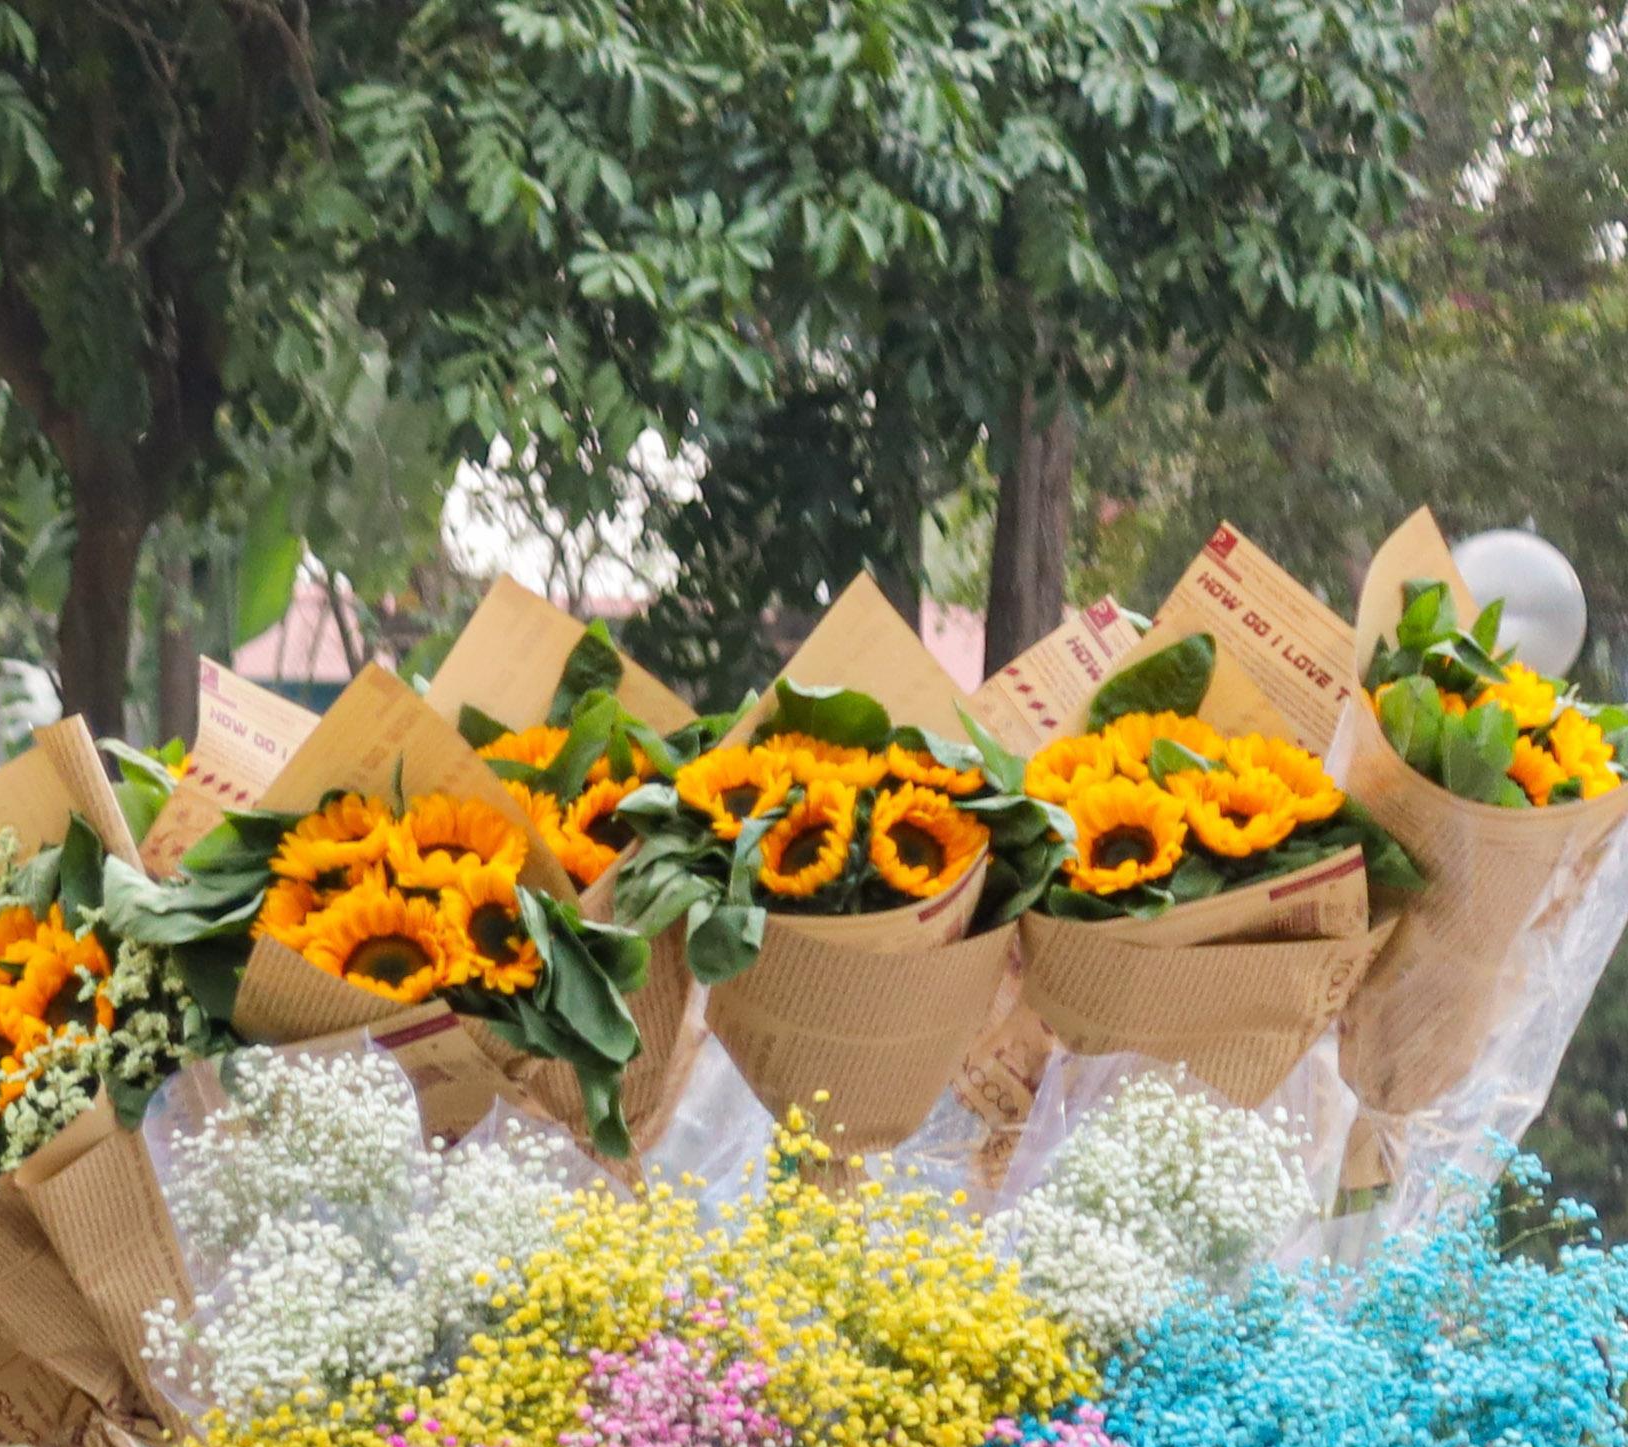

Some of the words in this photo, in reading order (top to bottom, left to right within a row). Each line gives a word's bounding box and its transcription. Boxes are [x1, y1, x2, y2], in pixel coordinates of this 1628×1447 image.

[1197, 571, 1243, 611] HOW
[1242, 610, 1272, 638] DO
[1282, 644, 1334, 689] LOVE
